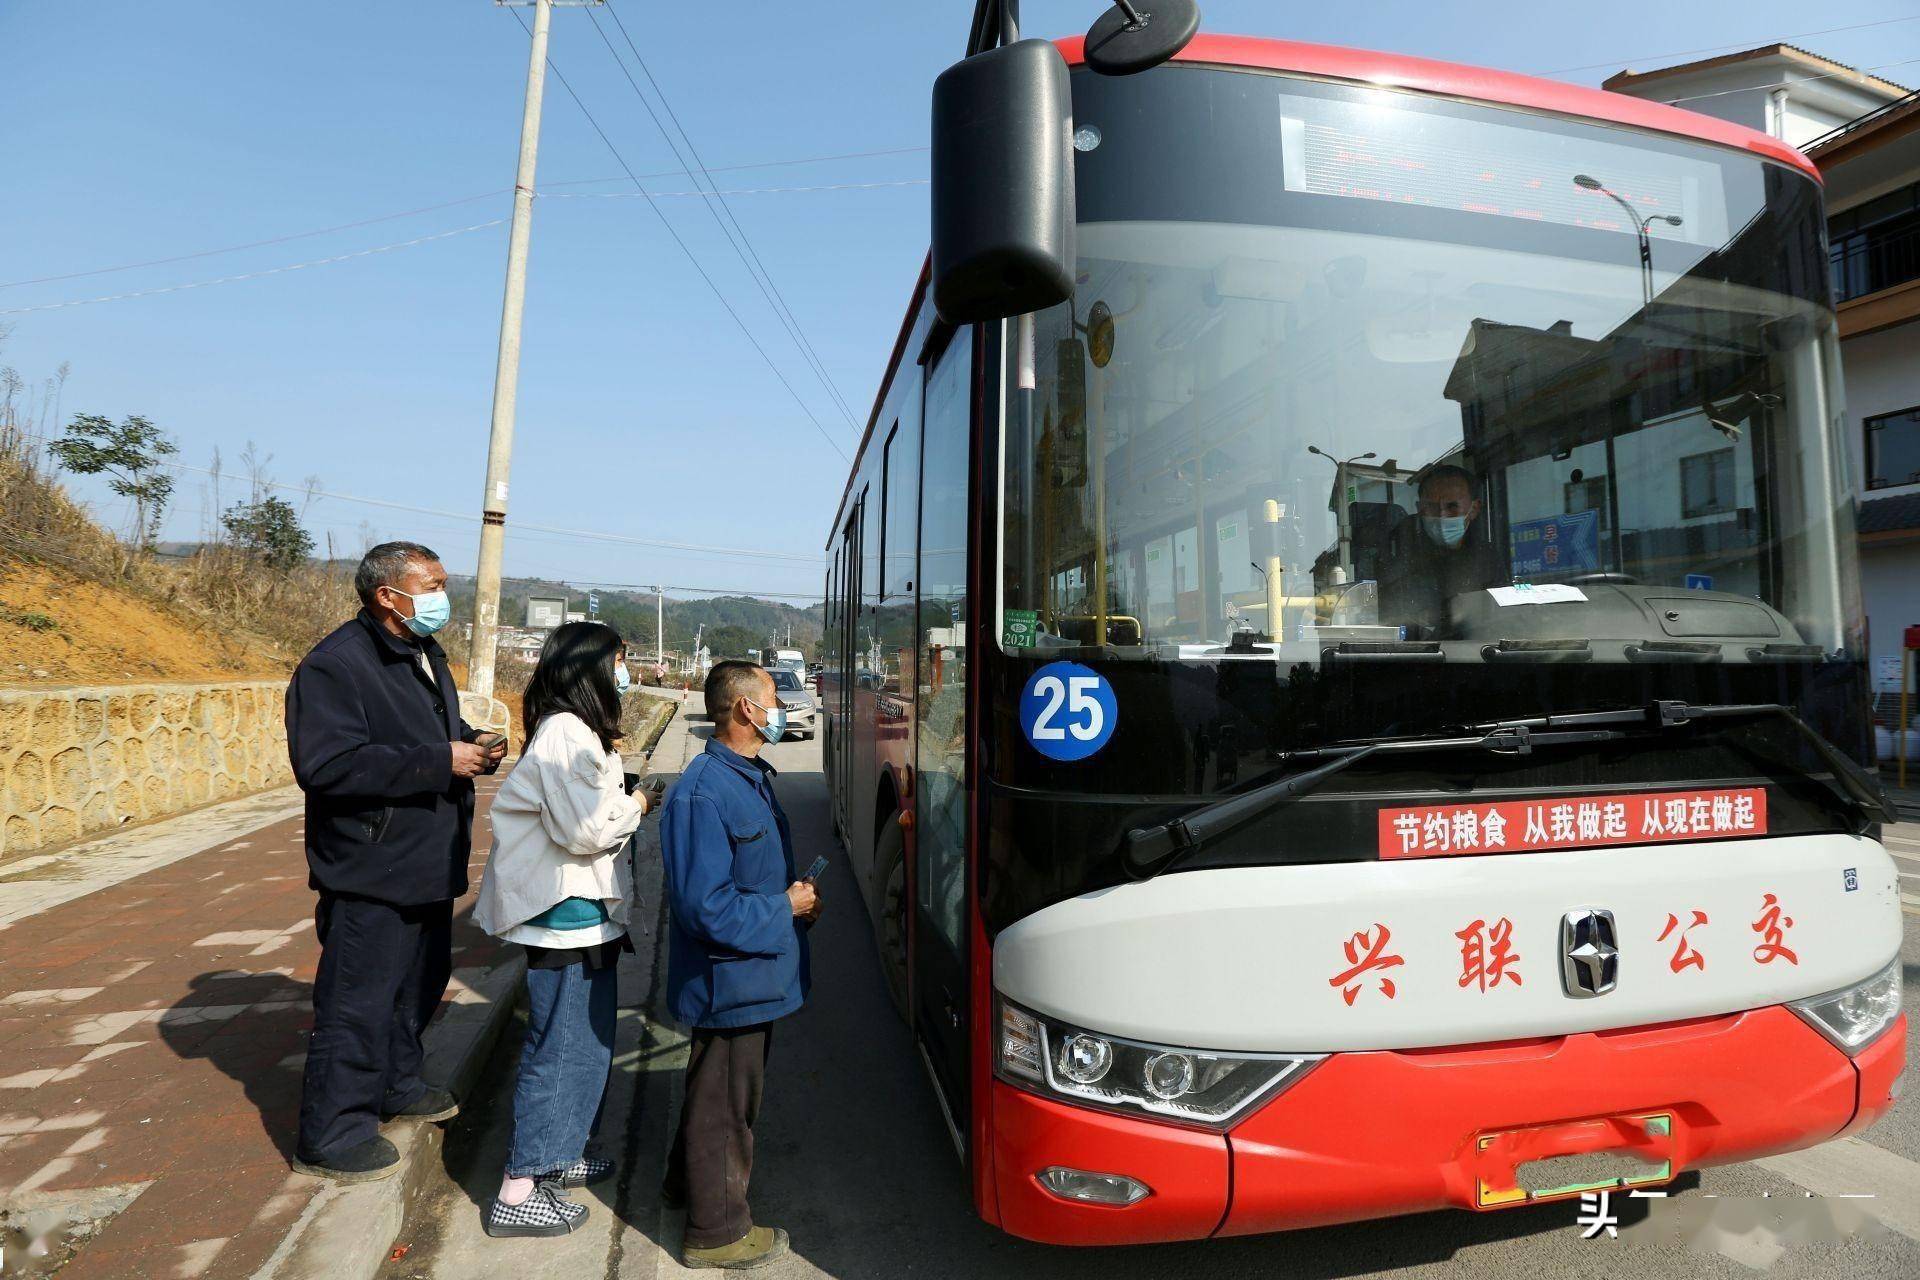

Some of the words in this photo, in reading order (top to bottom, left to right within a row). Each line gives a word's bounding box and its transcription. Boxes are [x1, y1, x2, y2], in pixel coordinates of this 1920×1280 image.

[1004, 632, 1030, 647] 2021
[1033, 676, 1103, 740] 25
[1393, 807, 1507, 853] 节约粮食
[1523, 801, 1628, 844] 从我做起
[1640, 796, 1755, 835] 从现在做起
[1329, 917, 1522, 1006] 兴联
[1656, 893, 1798, 974] 公交
